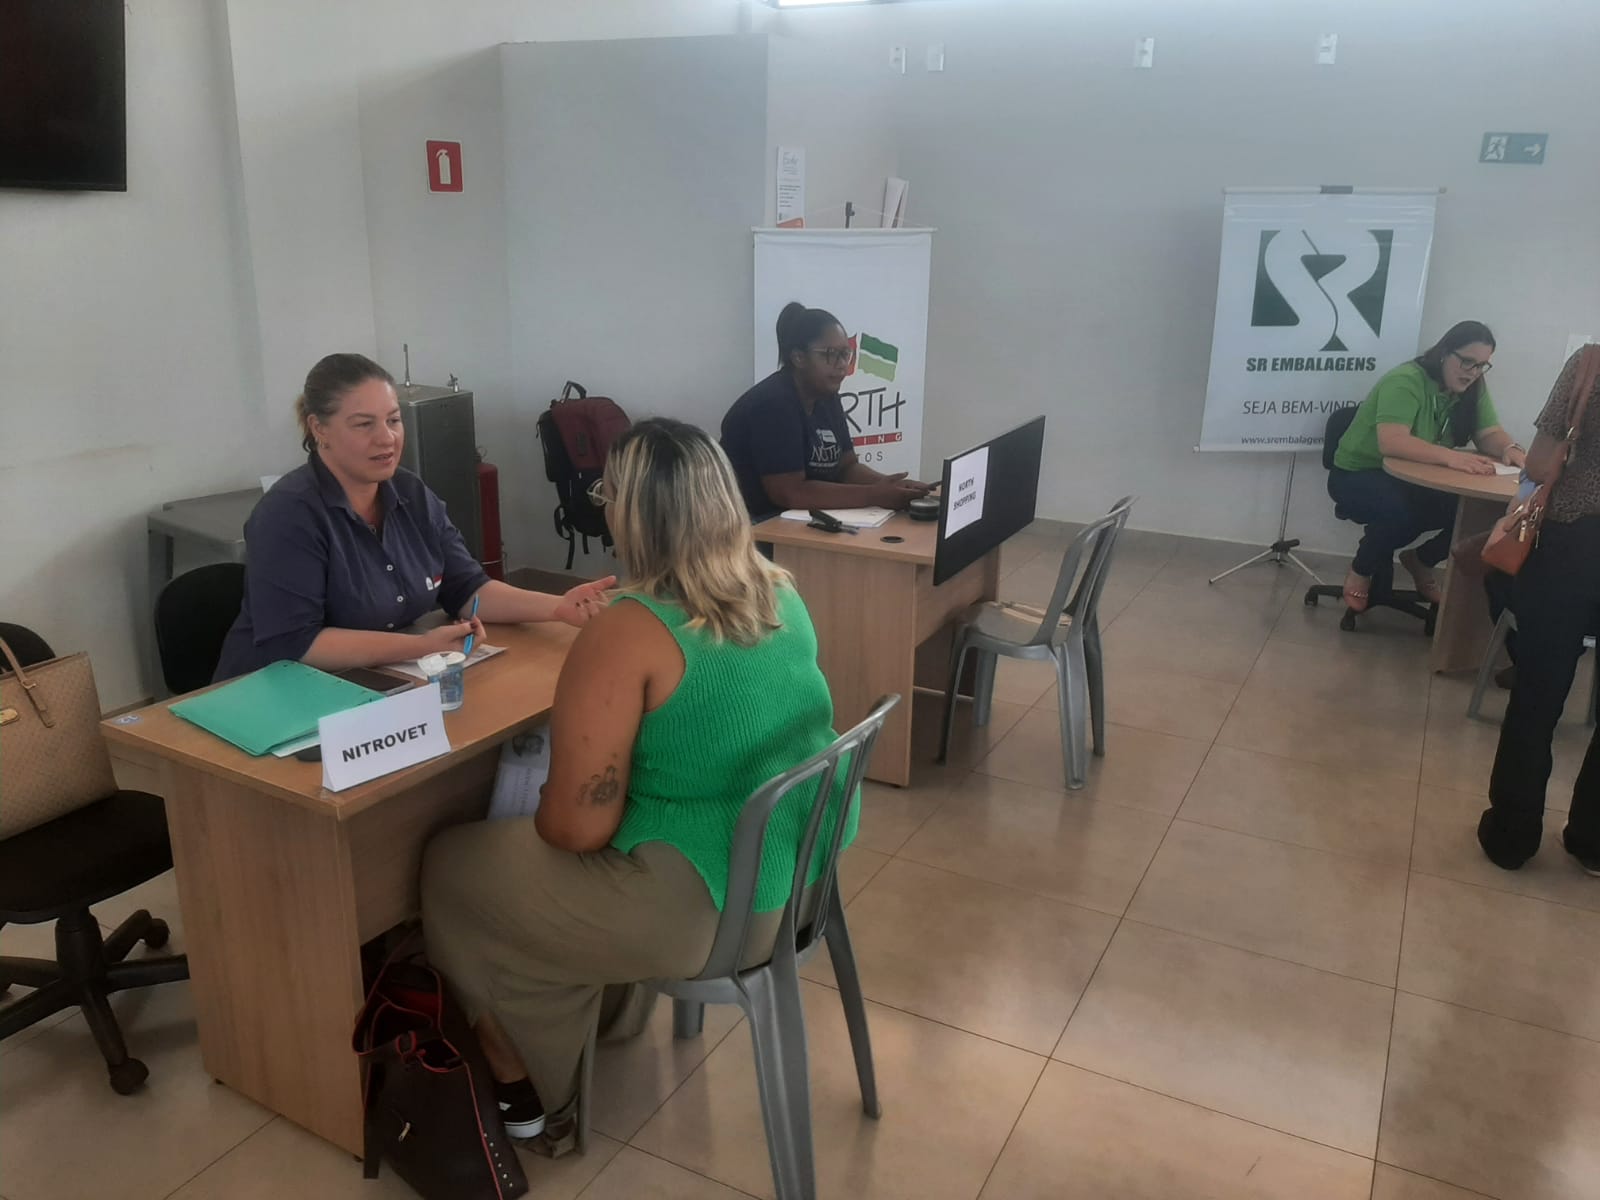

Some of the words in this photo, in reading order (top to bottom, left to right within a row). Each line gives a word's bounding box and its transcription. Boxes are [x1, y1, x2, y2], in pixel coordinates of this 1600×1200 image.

[1246, 357, 1268, 372] SR
[1271, 357, 1376, 372] EMBALAGENS
[1242, 400, 1277, 415] SEJA
[1241, 435, 1324, 446] www.srembalagen
[959, 476, 975, 492] NORTH
[953, 491, 977, 511] SHOPPING
[342, 723, 427, 762] NITROVET
